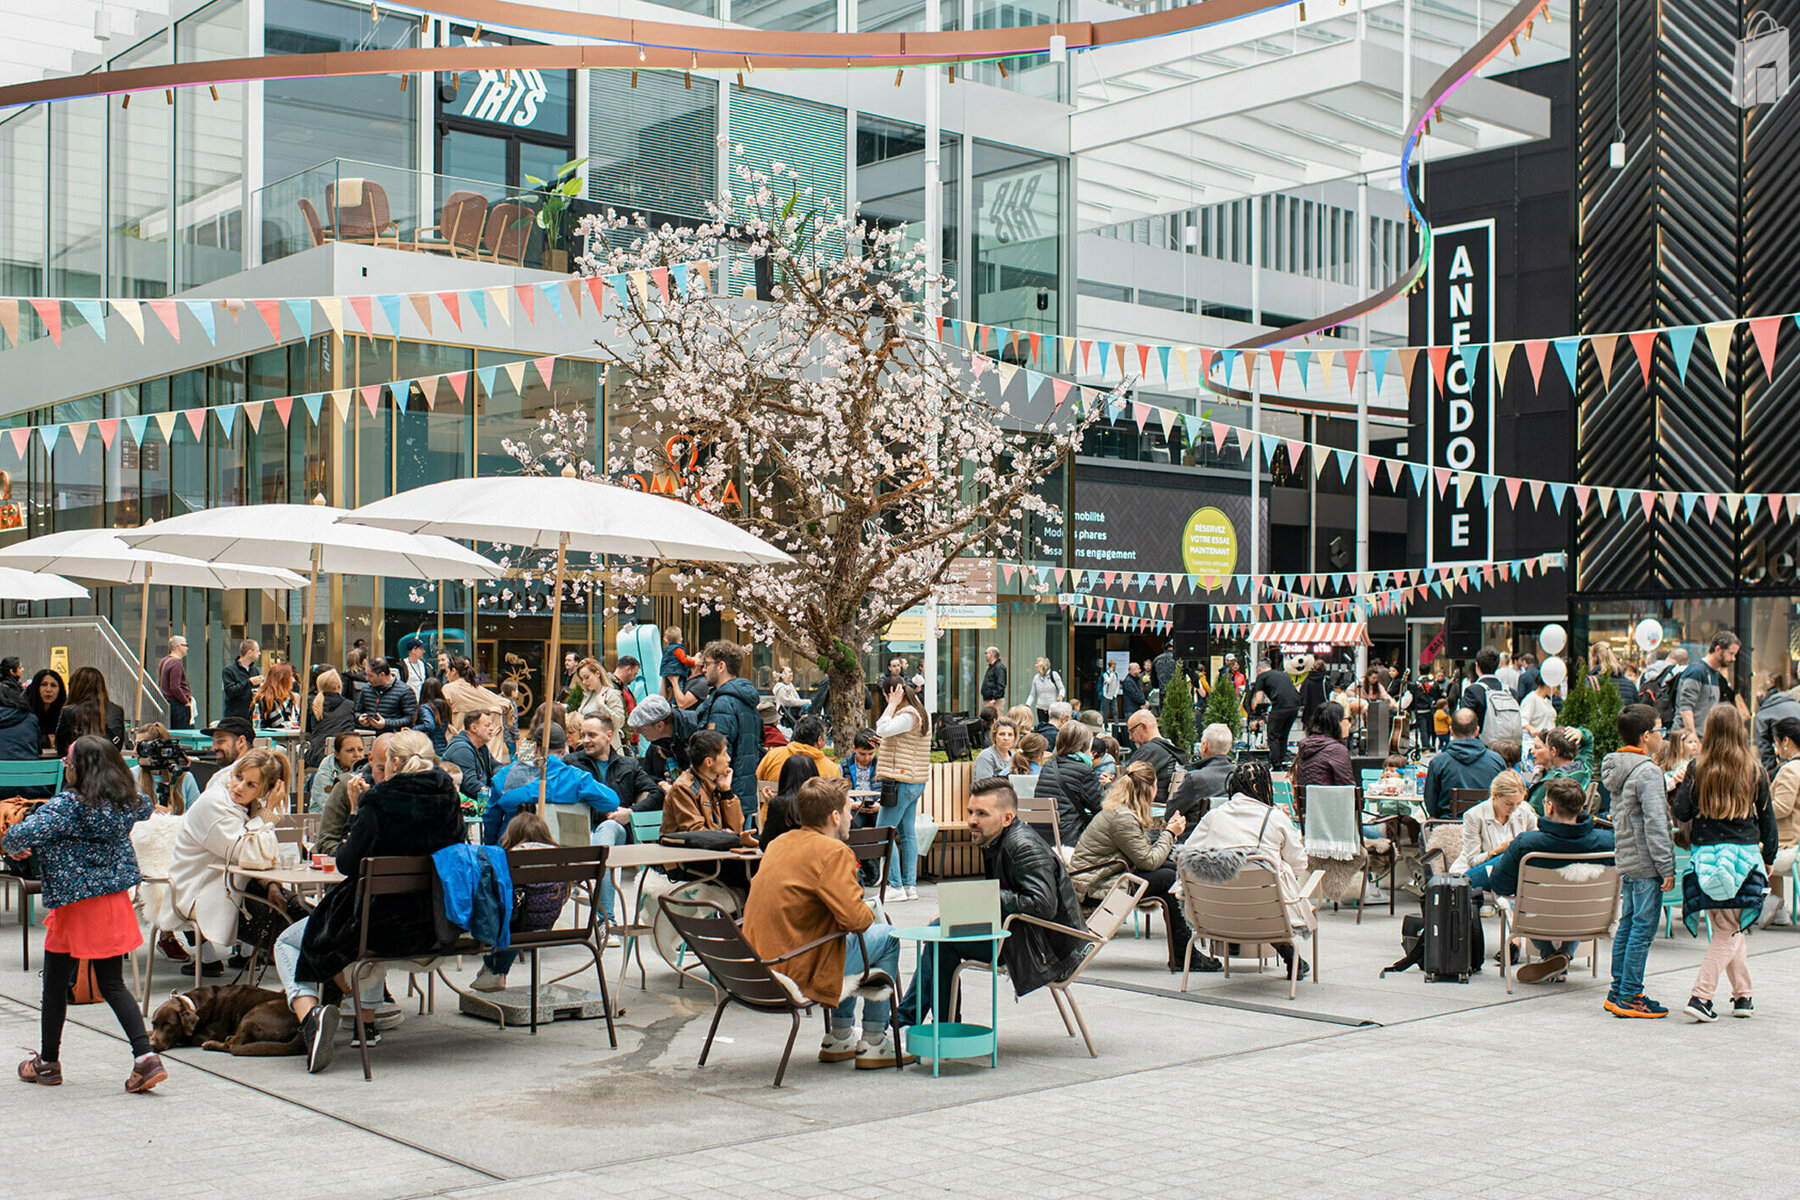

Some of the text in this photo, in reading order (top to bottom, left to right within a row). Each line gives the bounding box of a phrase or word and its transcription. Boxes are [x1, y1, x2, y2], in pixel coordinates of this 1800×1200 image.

[462, 80, 547, 128] IRIS
[1079, 529, 1107, 541] phares
[1190, 535, 1230, 545] VOTRE ESSAI
[1086, 549, 1136, 560] engagement
[1189, 546, 1231, 556] MAINTENANT
